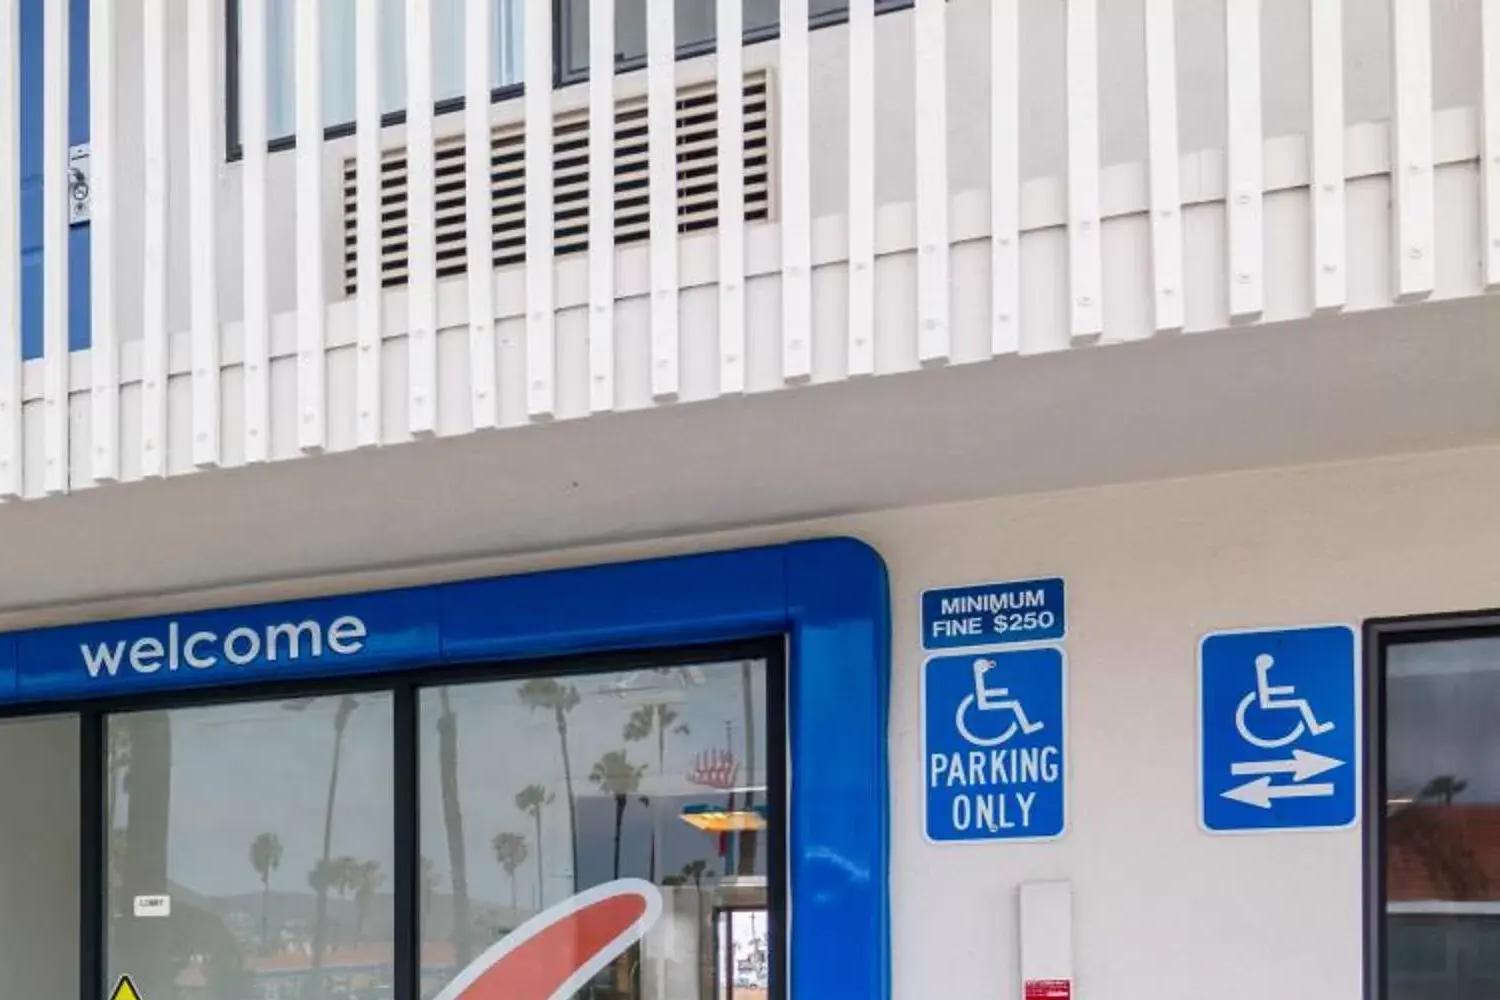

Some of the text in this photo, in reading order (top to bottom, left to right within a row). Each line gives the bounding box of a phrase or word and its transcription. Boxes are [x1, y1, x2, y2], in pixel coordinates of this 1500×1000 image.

[941, 589, 1045, 614] MINIMUM
[932, 610, 1055, 638] FINE $250
[80, 615, 367, 677] welcome
[931, 746, 1059, 787] PARKING
[952, 792, 1036, 831] ONLY
